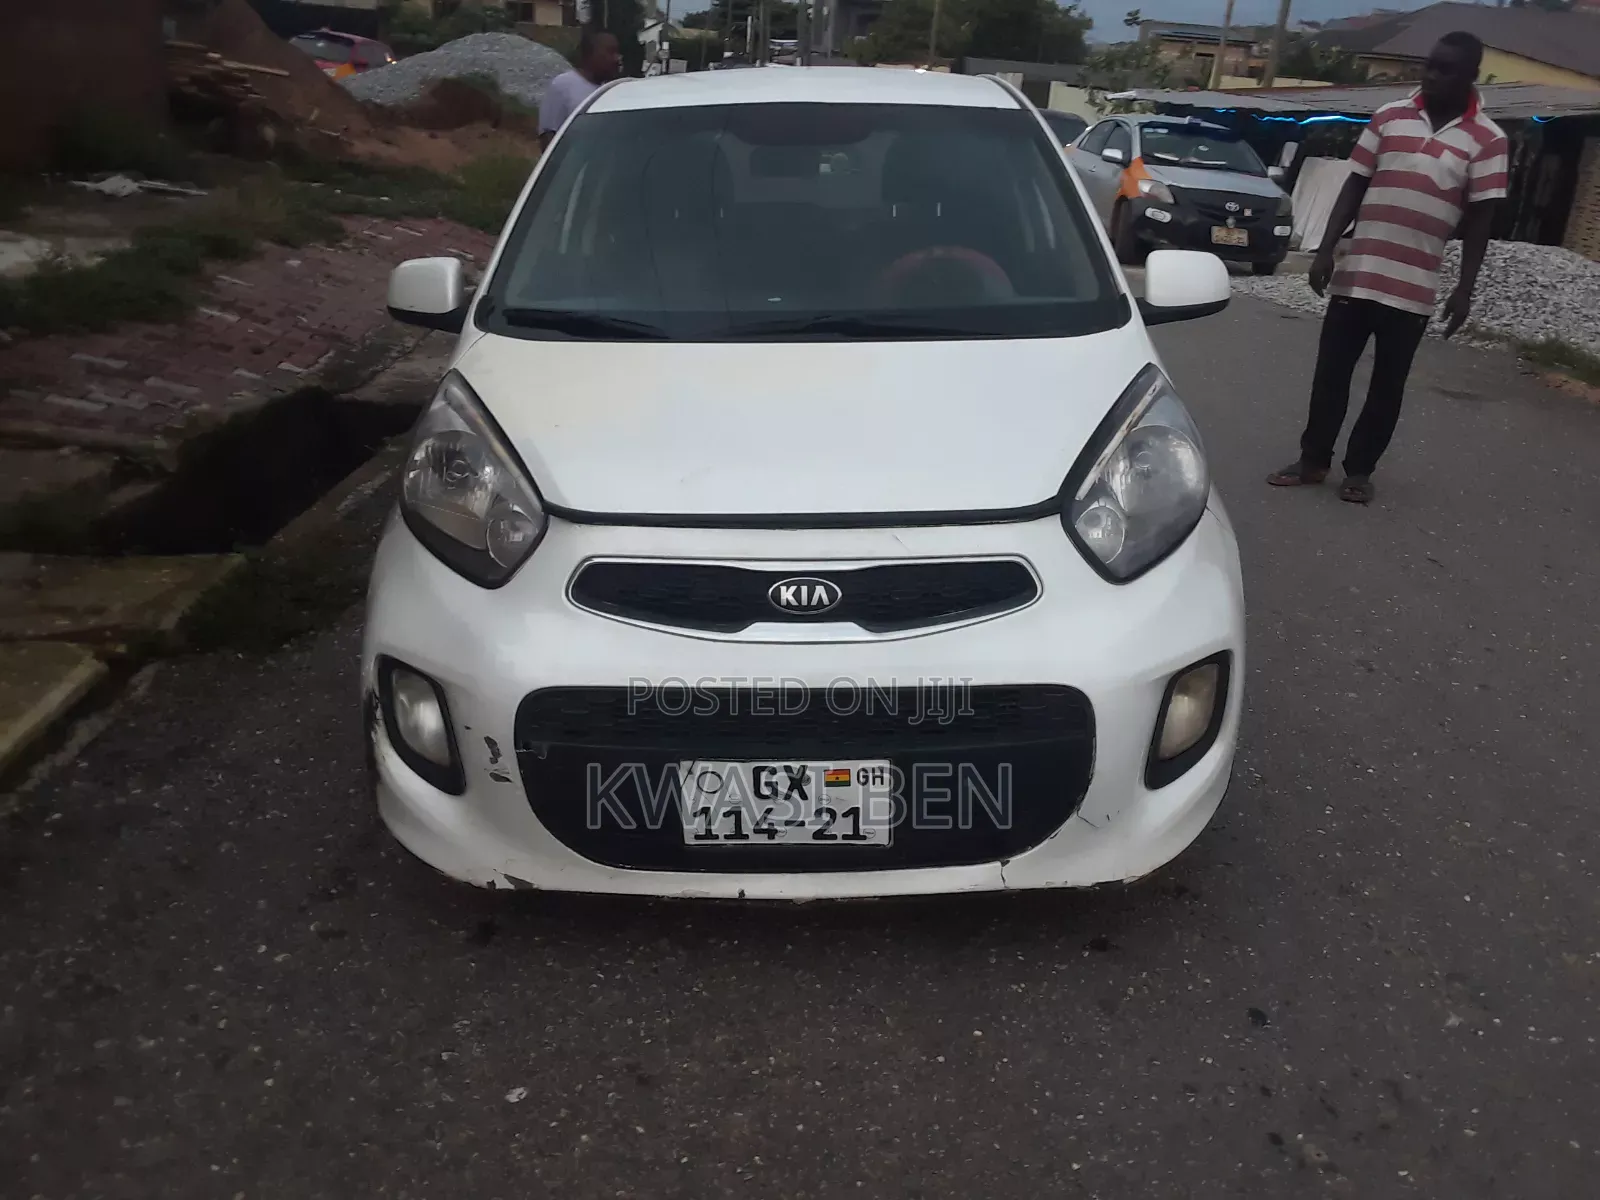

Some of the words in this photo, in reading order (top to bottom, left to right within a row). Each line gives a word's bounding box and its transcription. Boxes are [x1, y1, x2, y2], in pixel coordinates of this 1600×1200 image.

[779, 585, 831, 606] KIA
[752, 765, 809, 800] GX
[856, 767, 885, 786] GH
[693, 806, 867, 840] 114-21
